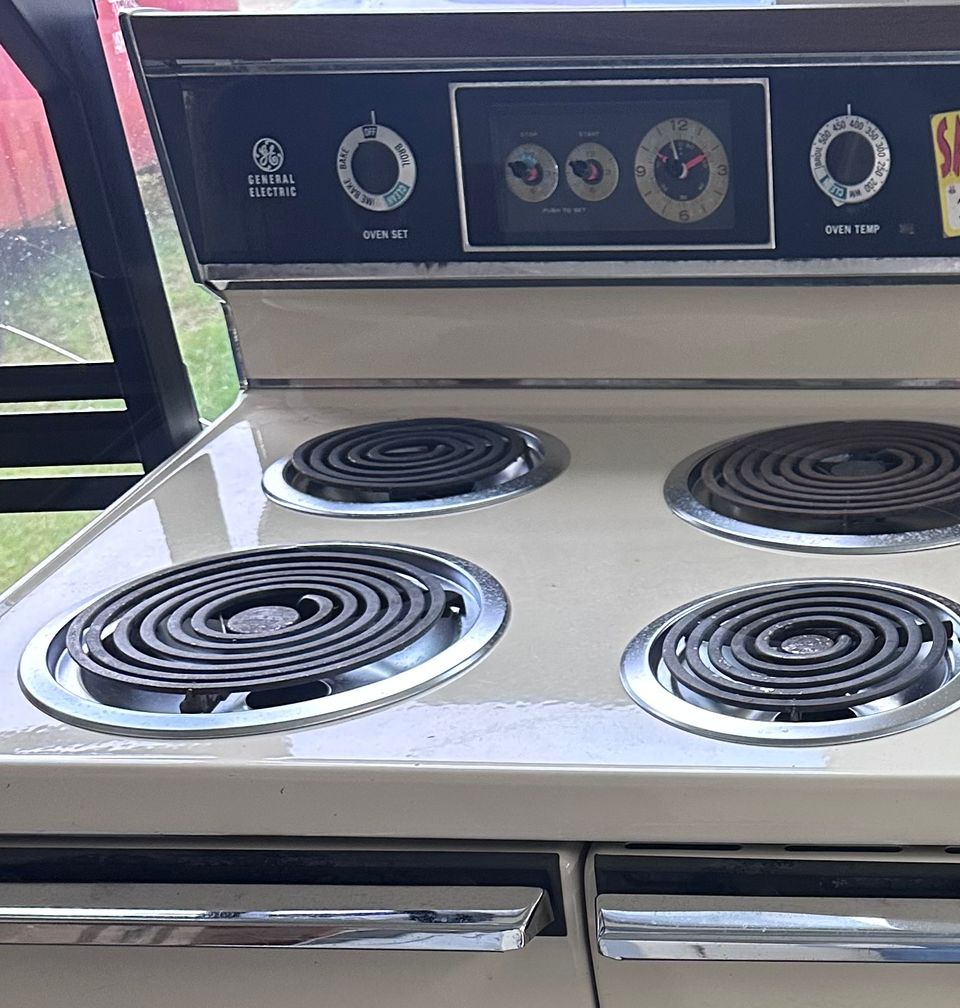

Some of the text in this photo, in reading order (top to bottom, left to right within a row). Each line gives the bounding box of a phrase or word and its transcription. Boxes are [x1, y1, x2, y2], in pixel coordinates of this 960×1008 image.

[670, 120, 688, 130] 12
[832, 120, 846, 131] 450
[850, 118, 864, 130] 400
[364, 127, 377, 138] OFF
[819, 130, 832, 145] 500
[864, 127, 878, 141] 350
[394, 143, 412, 168] BROIL
[874, 141, 886, 158] 300
[340, 147, 350, 170] BAKE
[636, 166, 646, 176] 9
[718, 164, 728, 176] 3
[874, 160, 887, 177] 250
[248, 175, 296, 184] GENERAL
[864, 178, 878, 192] 200
[249, 187, 296, 197] ELECTRIC
[343, 178, 362, 200] BAKE
[680, 210, 690, 221] 6
[363, 230, 408, 240] OVEN SET
[825, 224, 880, 234] OVEN TEMP
